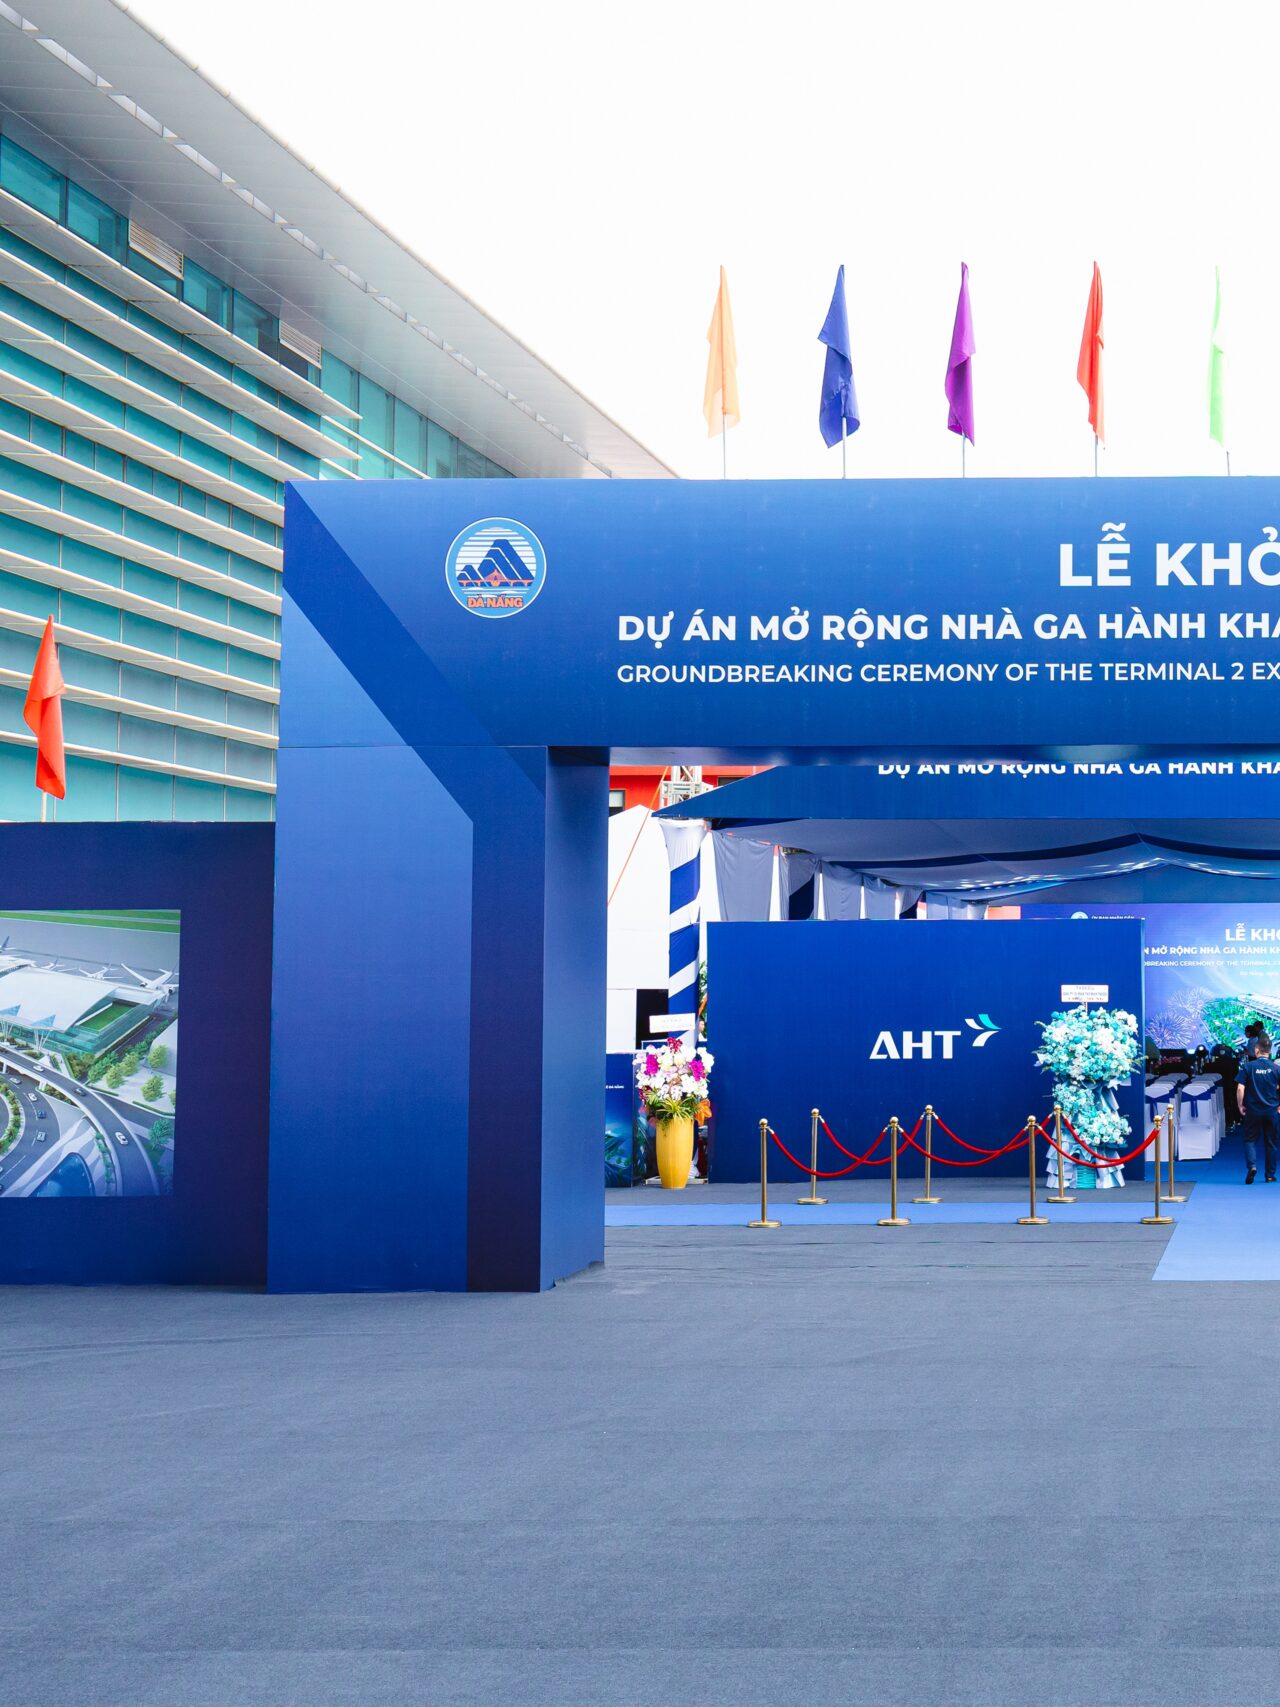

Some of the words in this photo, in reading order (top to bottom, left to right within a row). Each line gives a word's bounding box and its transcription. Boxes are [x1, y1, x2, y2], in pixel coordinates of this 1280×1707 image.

[1059, 522, 1131, 587] LỄ
[618, 610, 676, 650] DỰ
[683, 608, 736, 641] ÁN
[750, 605, 811, 641] MỞ
[822, 607, 928, 649] RỘNG
[942, 607, 1023, 640] NHÀ
[1033, 613, 1087, 640] GA
[1099, 606, 1205, 639] HÀNH
[617, 664, 852, 683] GROUNDBREAKING
[860, 663, 999, 682] CEREMONY
[1005, 663, 1039, 682] OF
[1045, 663, 1093, 681] THE
[1099, 662, 1225, 681] TERMINAL
[1231, 662, 1244, 680] 2
[1225, 922, 1246, 942] LỄ
[1151, 944, 1168, 955] MỞ
[1169, 945, 1198, 957] RỘNG
[1199, 944, 1221, 955] NHÀ
[1222, 946, 1237, 955] GA
[1239, 944, 1267, 955] HÀNH
[869, 1031, 962, 1060] AHT
